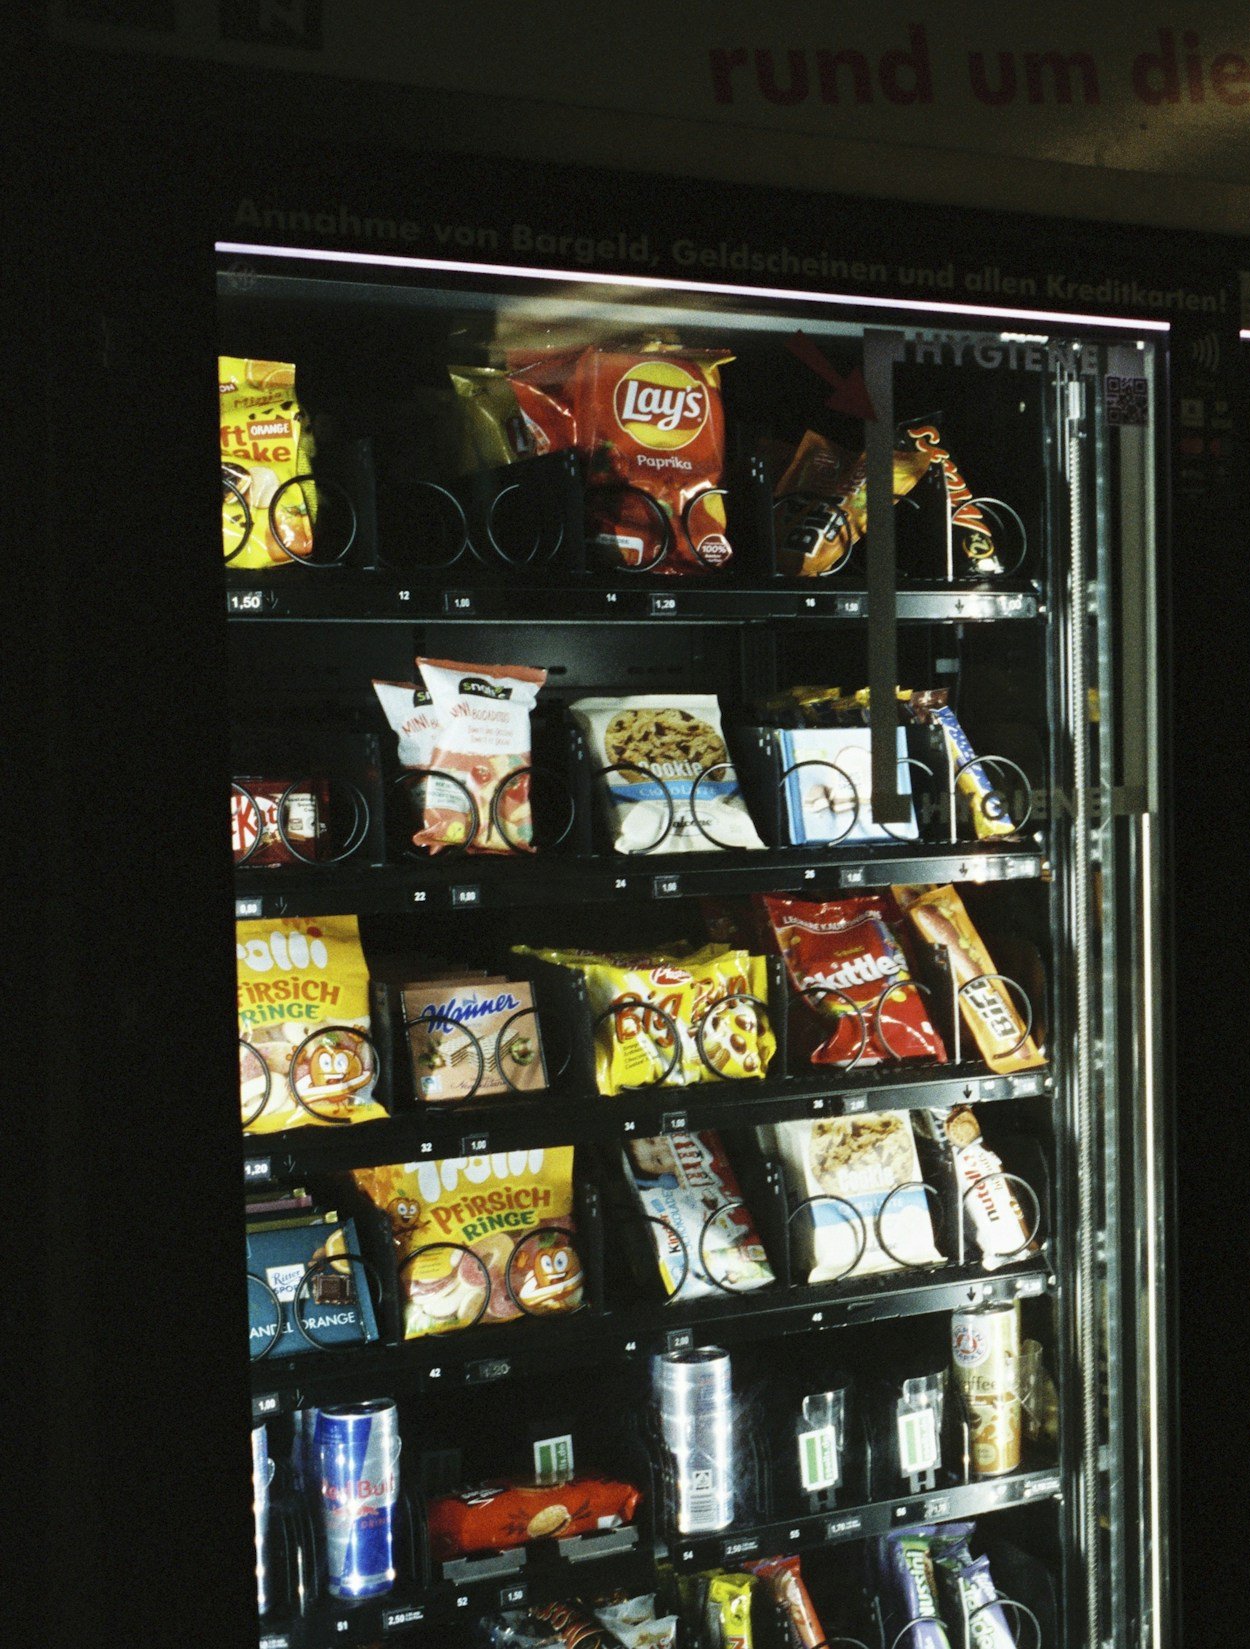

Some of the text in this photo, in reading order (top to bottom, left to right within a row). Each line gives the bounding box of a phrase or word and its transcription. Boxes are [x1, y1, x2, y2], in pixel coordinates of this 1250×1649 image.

[709, 24, 934, 104] rund
[968, 48, 1099, 104] um
[235, 201, 1228, 314] Annahme von Bargeld, Geldscheinen und allen Kreditkarten!
[915, 332, 1099, 375] HYGIENE
[621, 380, 705, 431] Lay's
[250, 423, 291, 436] ORANGE
[221, 425, 247, 448] ft
[636, 454, 693, 471] Paprika
[702, 544, 729, 555] 100%
[398, 590, 411, 601] 12
[605, 593, 617, 603] 14
[231, 595, 261, 610] 1,50
[414, 891, 426, 902] 22
[420, 991, 521, 1035] Manner
[420, 1143, 433, 1153] 32
[244, 1163, 268, 1176] 1,20
[271, 1268, 302, 1285] Ritter
[625, 1341, 637, 1351] 44
[429, 1368, 442, 1379] 42
[456, 1596, 469, 1608] 52
[336, 1620, 349, 1632] 51
